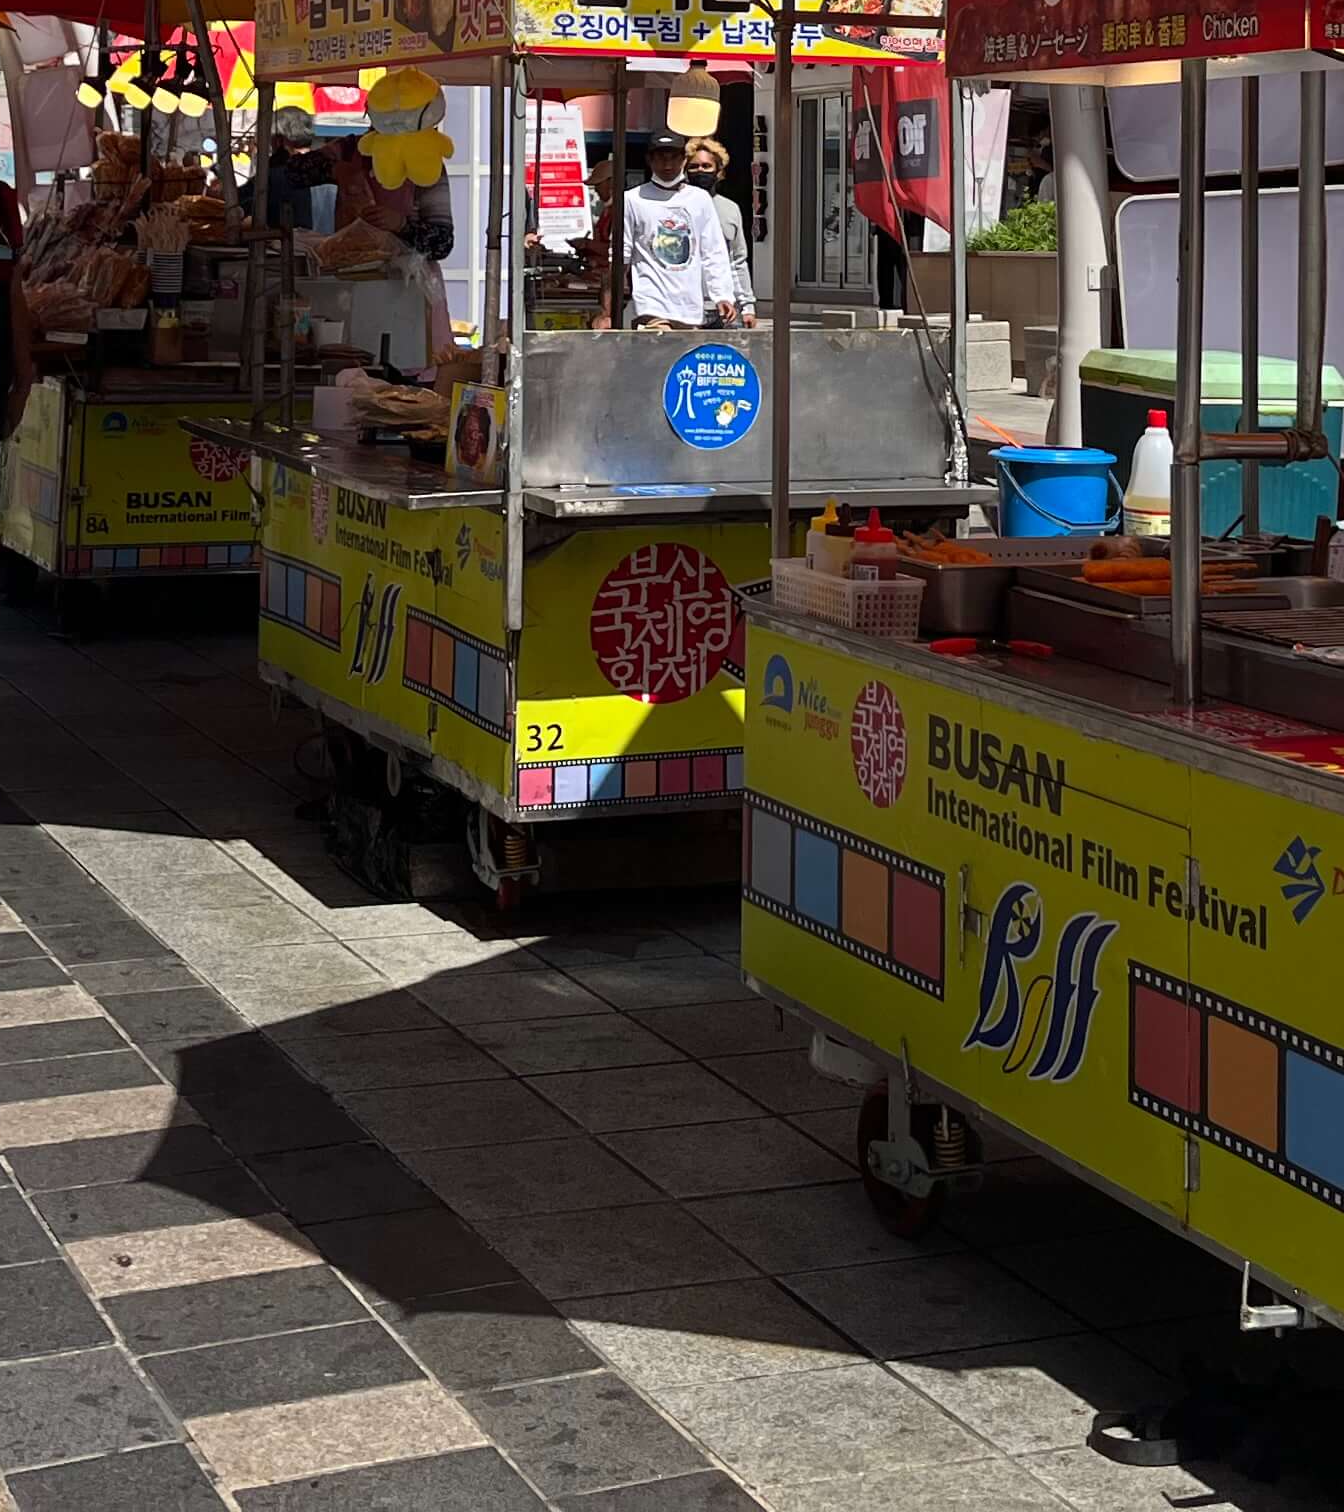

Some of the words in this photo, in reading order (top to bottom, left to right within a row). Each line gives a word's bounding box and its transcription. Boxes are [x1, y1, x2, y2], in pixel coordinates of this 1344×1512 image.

[552, 12, 682, 44] 오징어무침
[1202, 13, 1259, 41] Chicken
[697, 361, 745, 377] BUSAN
[126, 491, 212, 509] BUSAN
[337, 486, 387, 530] BUSAN
[85, 516, 110, 534] 84
[126, 510, 218, 524] International
[221, 509, 251, 522] Film
[390, 540, 412, 571] Film
[607, 543, 718, 612] 부산
[798, 677, 827, 713] Nice
[526, 723, 565, 752] 32
[927, 712, 1066, 818] BUSAN
[927, 777, 1074, 881] International
[1081, 839, 1139, 901] Film
